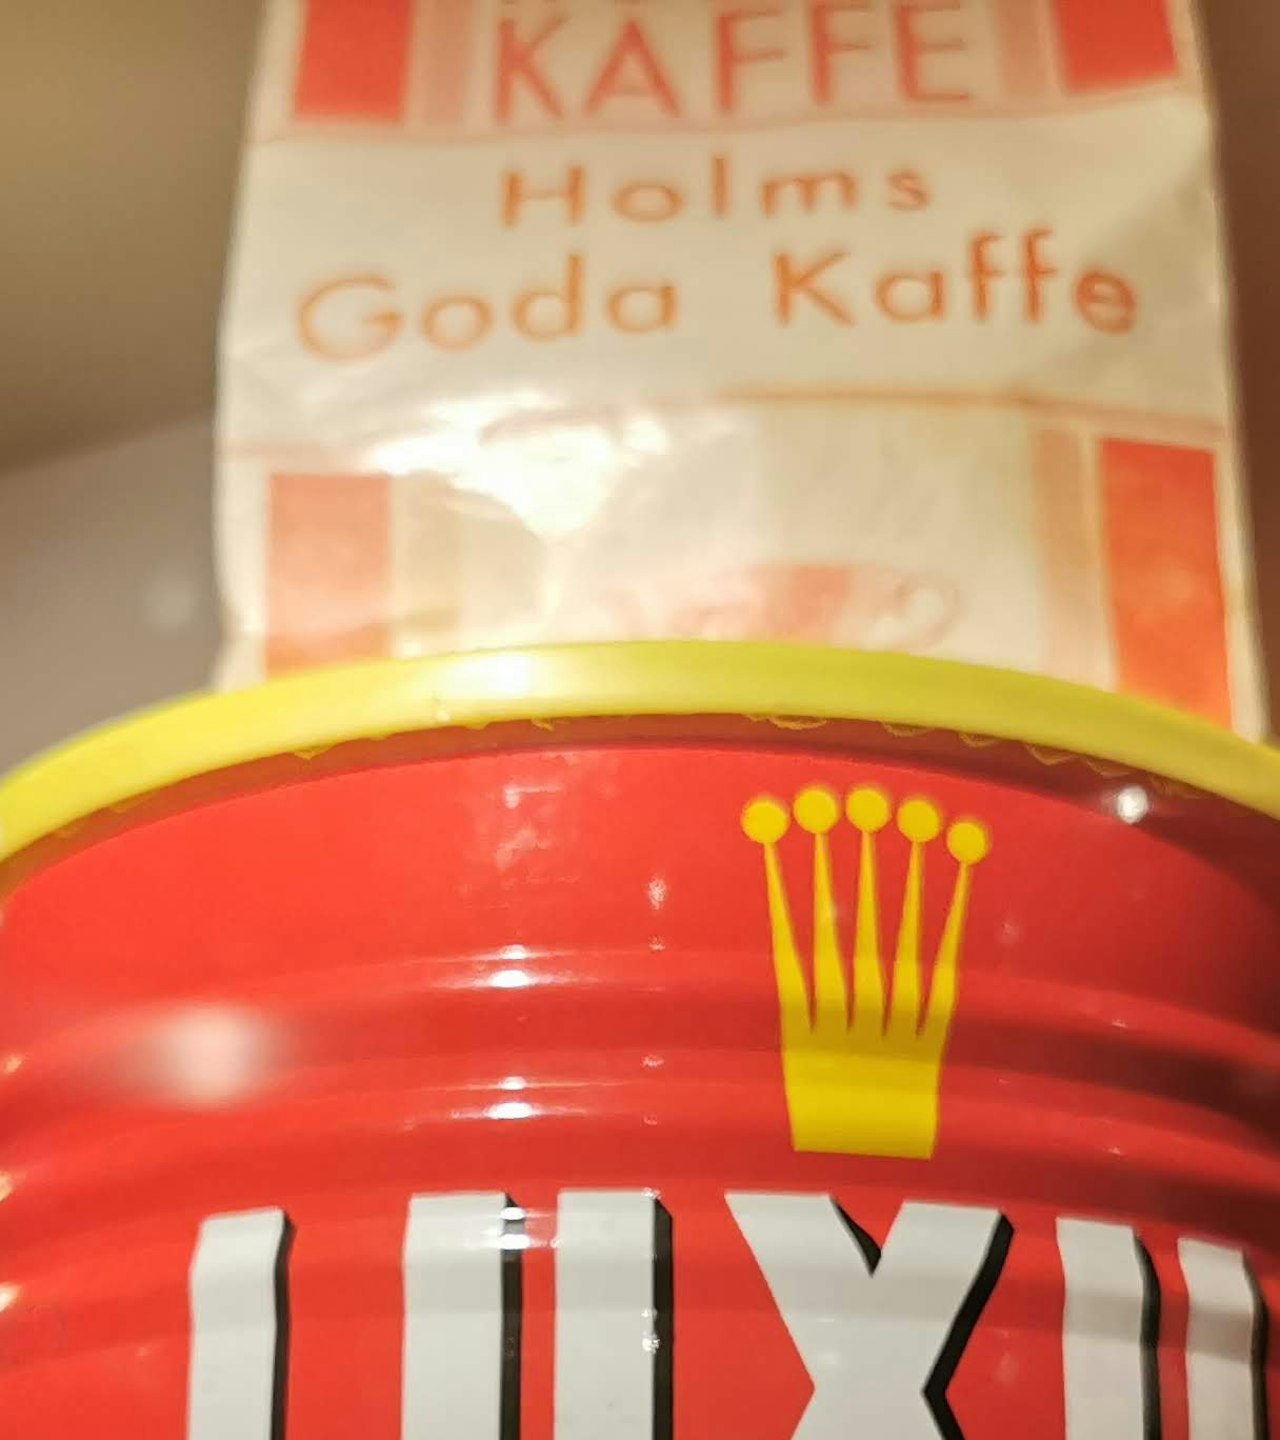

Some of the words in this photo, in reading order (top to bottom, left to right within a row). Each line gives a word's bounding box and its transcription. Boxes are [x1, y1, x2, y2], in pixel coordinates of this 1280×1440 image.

[500, 154, 932, 227] Holms
[295, 253, 677, 360] Goda
[772, 228, 1137, 335] Kaffe
